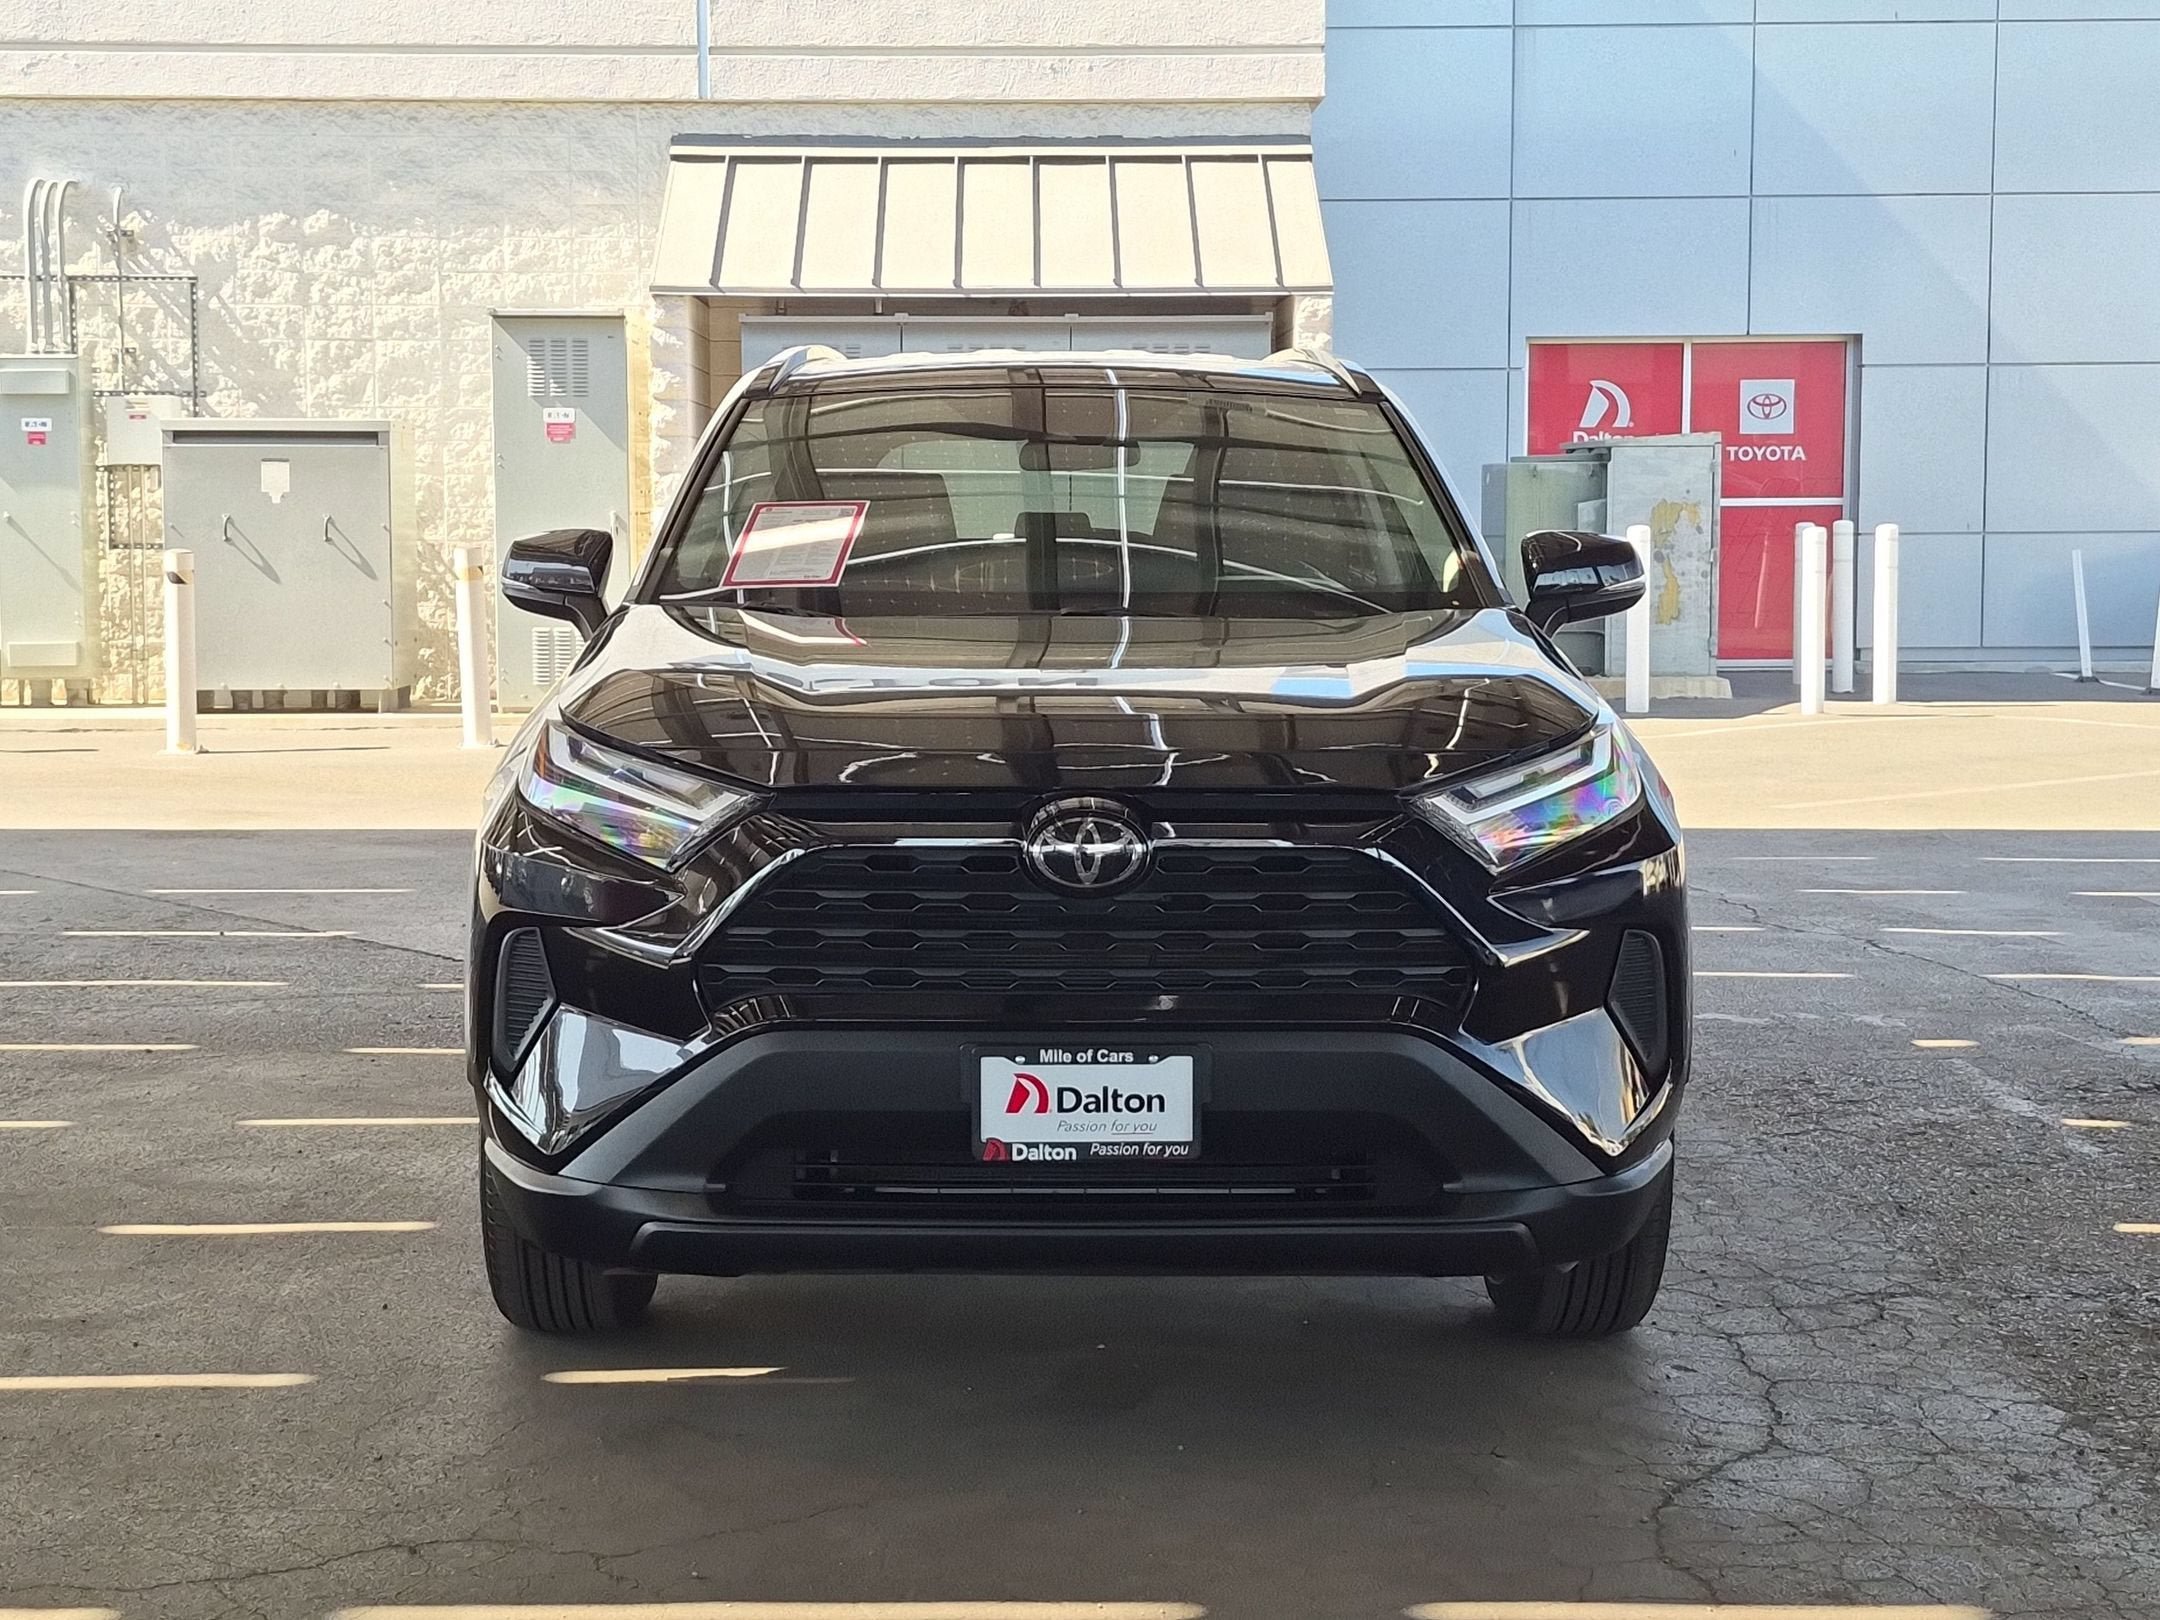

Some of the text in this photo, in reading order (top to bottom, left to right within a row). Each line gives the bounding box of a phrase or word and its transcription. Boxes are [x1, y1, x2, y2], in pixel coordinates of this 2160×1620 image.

[1726, 446, 1806, 461] TOYOTA
[1040, 1049, 1134, 1063] Mile of Cars
[1057, 1086, 1165, 1113] Dalton
[1057, 1120, 1158, 1134] Passion for you
[1012, 1143, 1077, 1161] Dalton
[1090, 1143, 1189, 1157] Passion for you
